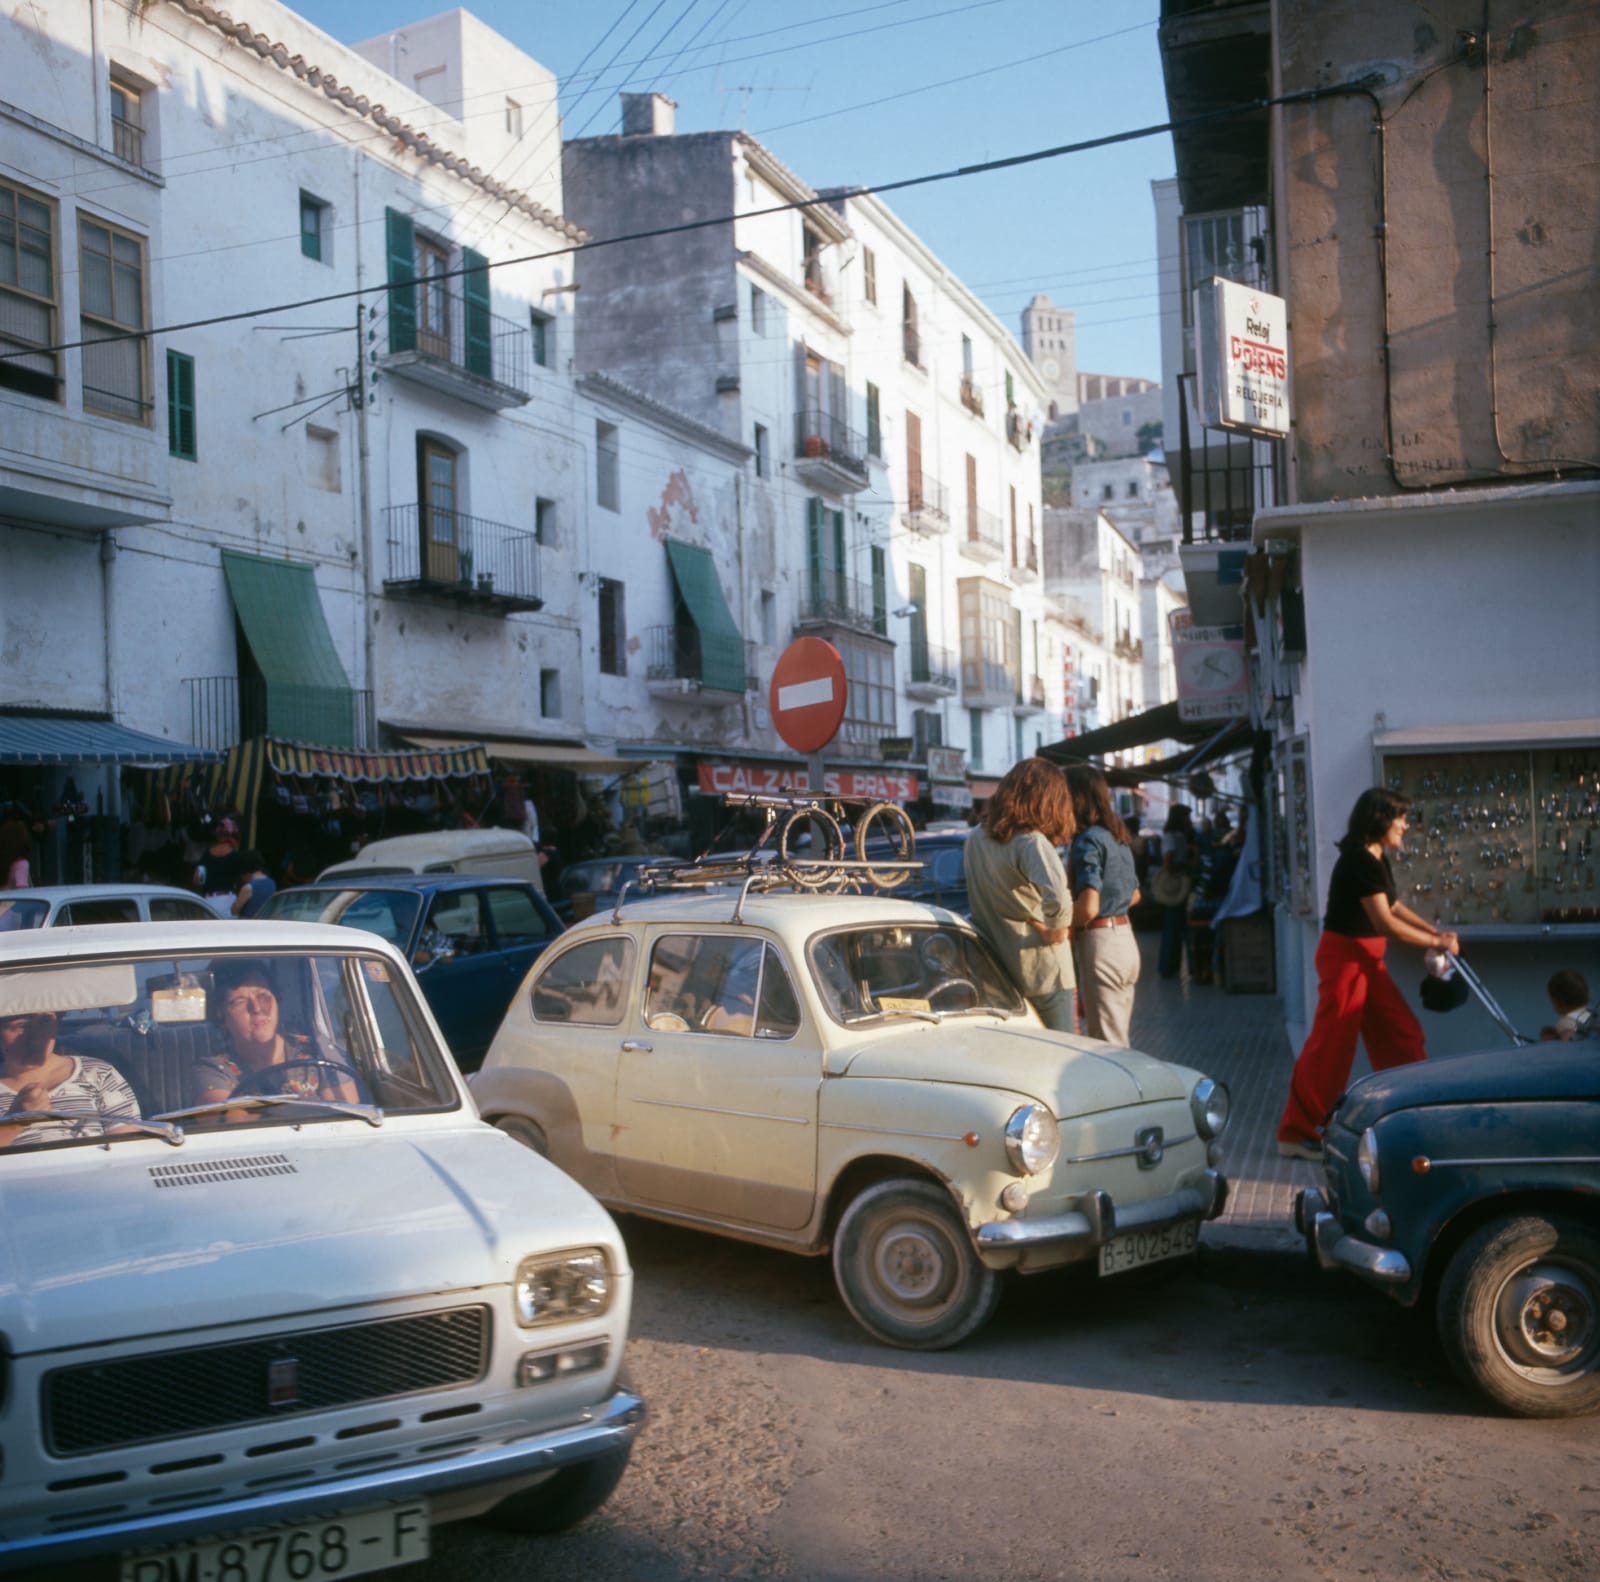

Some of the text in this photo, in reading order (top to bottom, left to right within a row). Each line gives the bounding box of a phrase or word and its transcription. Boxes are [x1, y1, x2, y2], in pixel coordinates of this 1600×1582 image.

[1246, 316, 1270, 345] Reloj
[1236, 385, 1283, 408] RELOJERIA
[711, 765, 841, 794] CALZADS
[852, 774, 910, 798] PRATS
